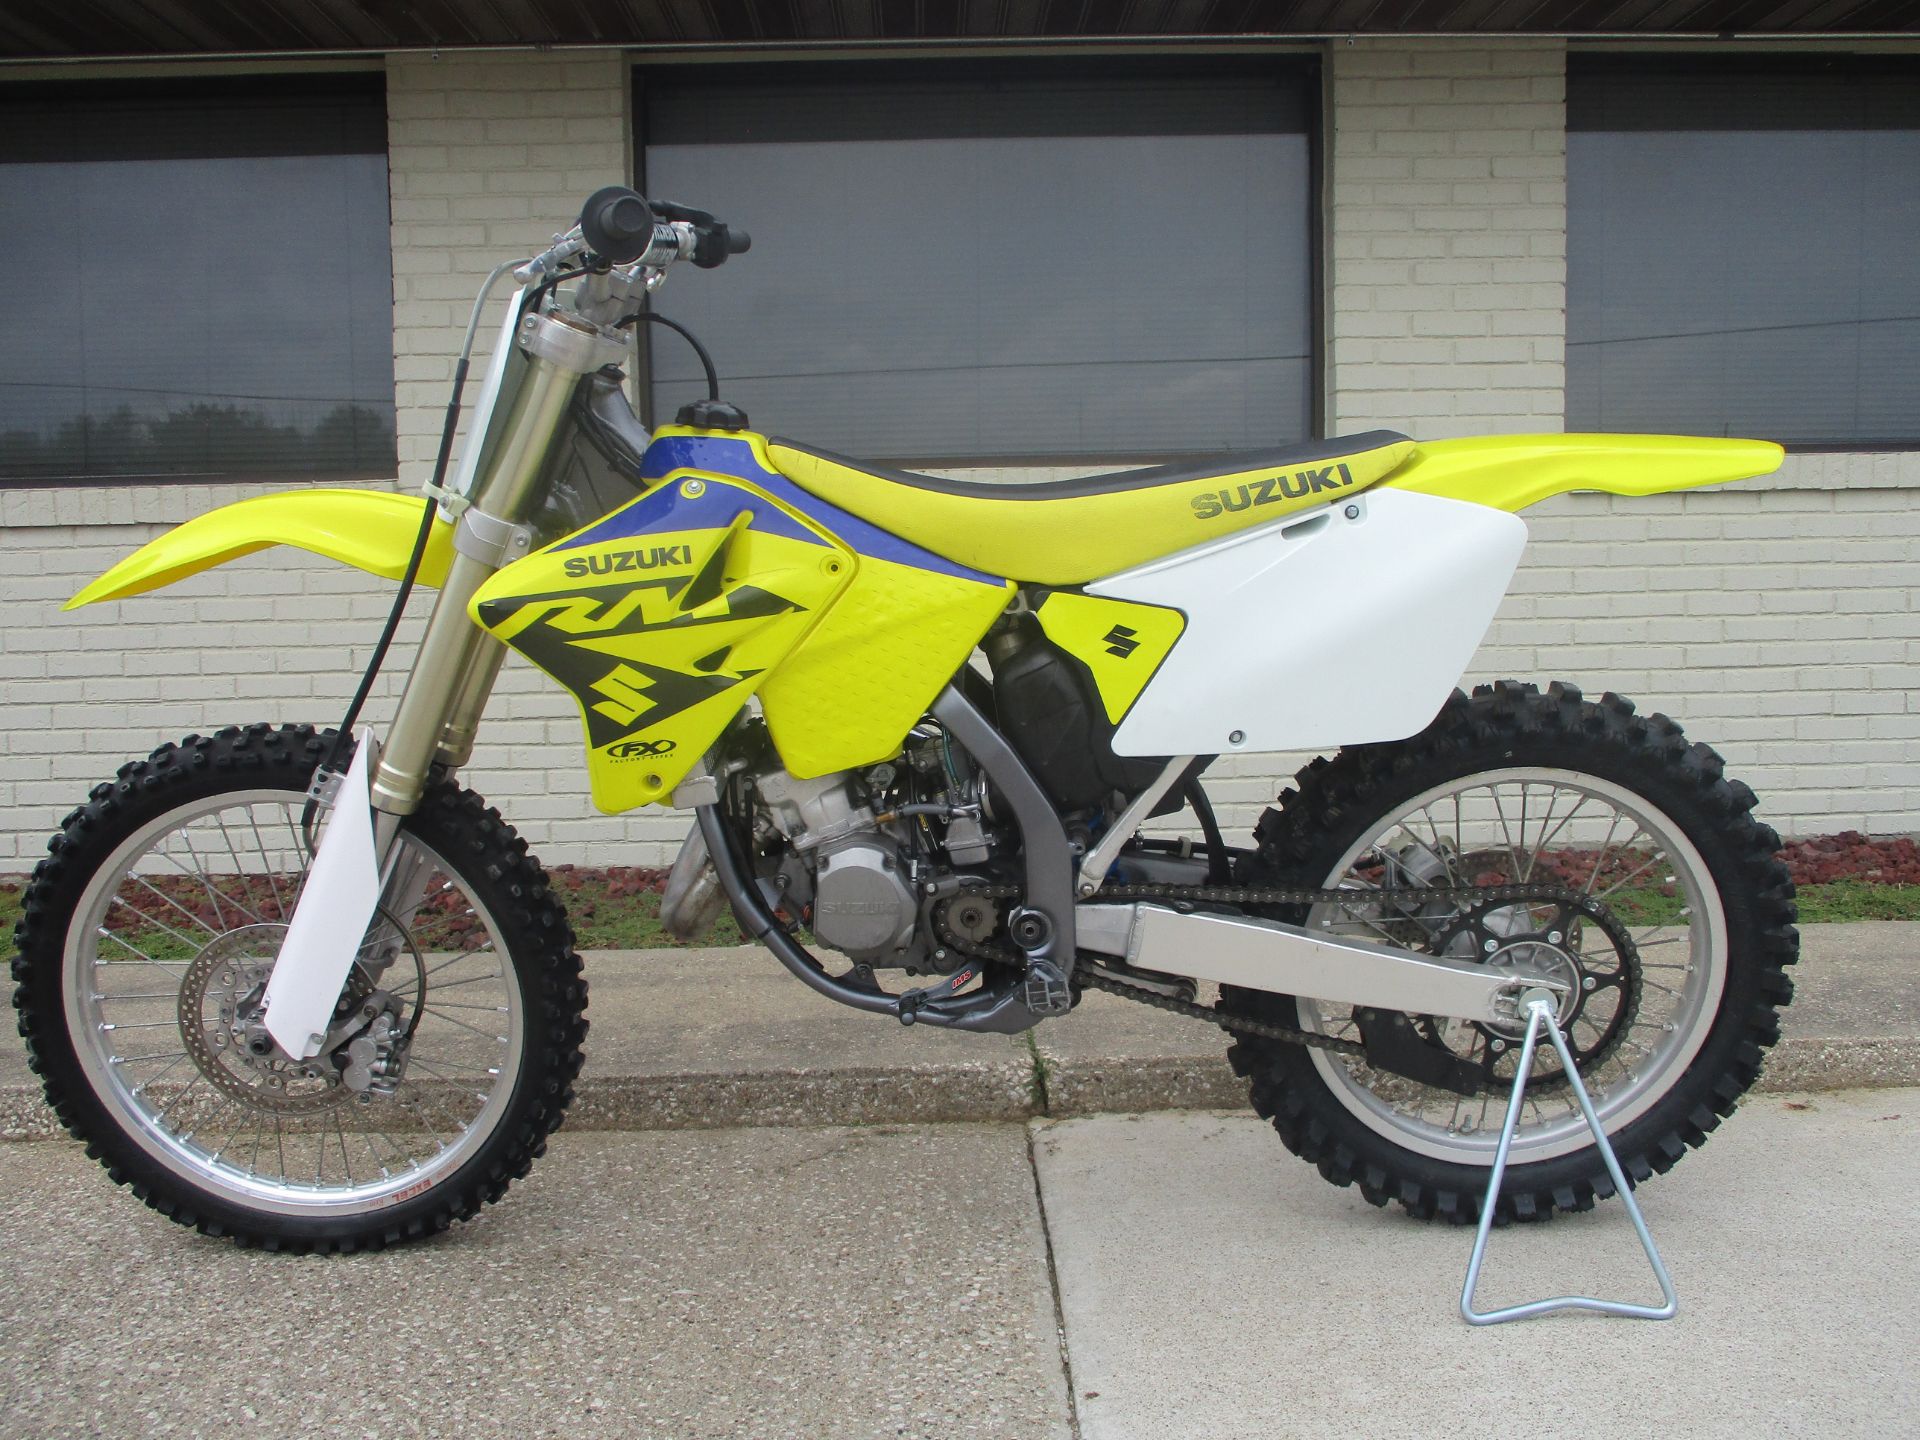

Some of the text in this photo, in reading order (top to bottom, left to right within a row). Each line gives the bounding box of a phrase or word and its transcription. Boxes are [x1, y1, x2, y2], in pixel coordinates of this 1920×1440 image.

[1190, 463, 1353, 519] SUZUKI
[563, 545, 692, 578] SUZUKI
[952, 969, 973, 989] IMS
[392, 1178, 433, 1202] EXCEL
